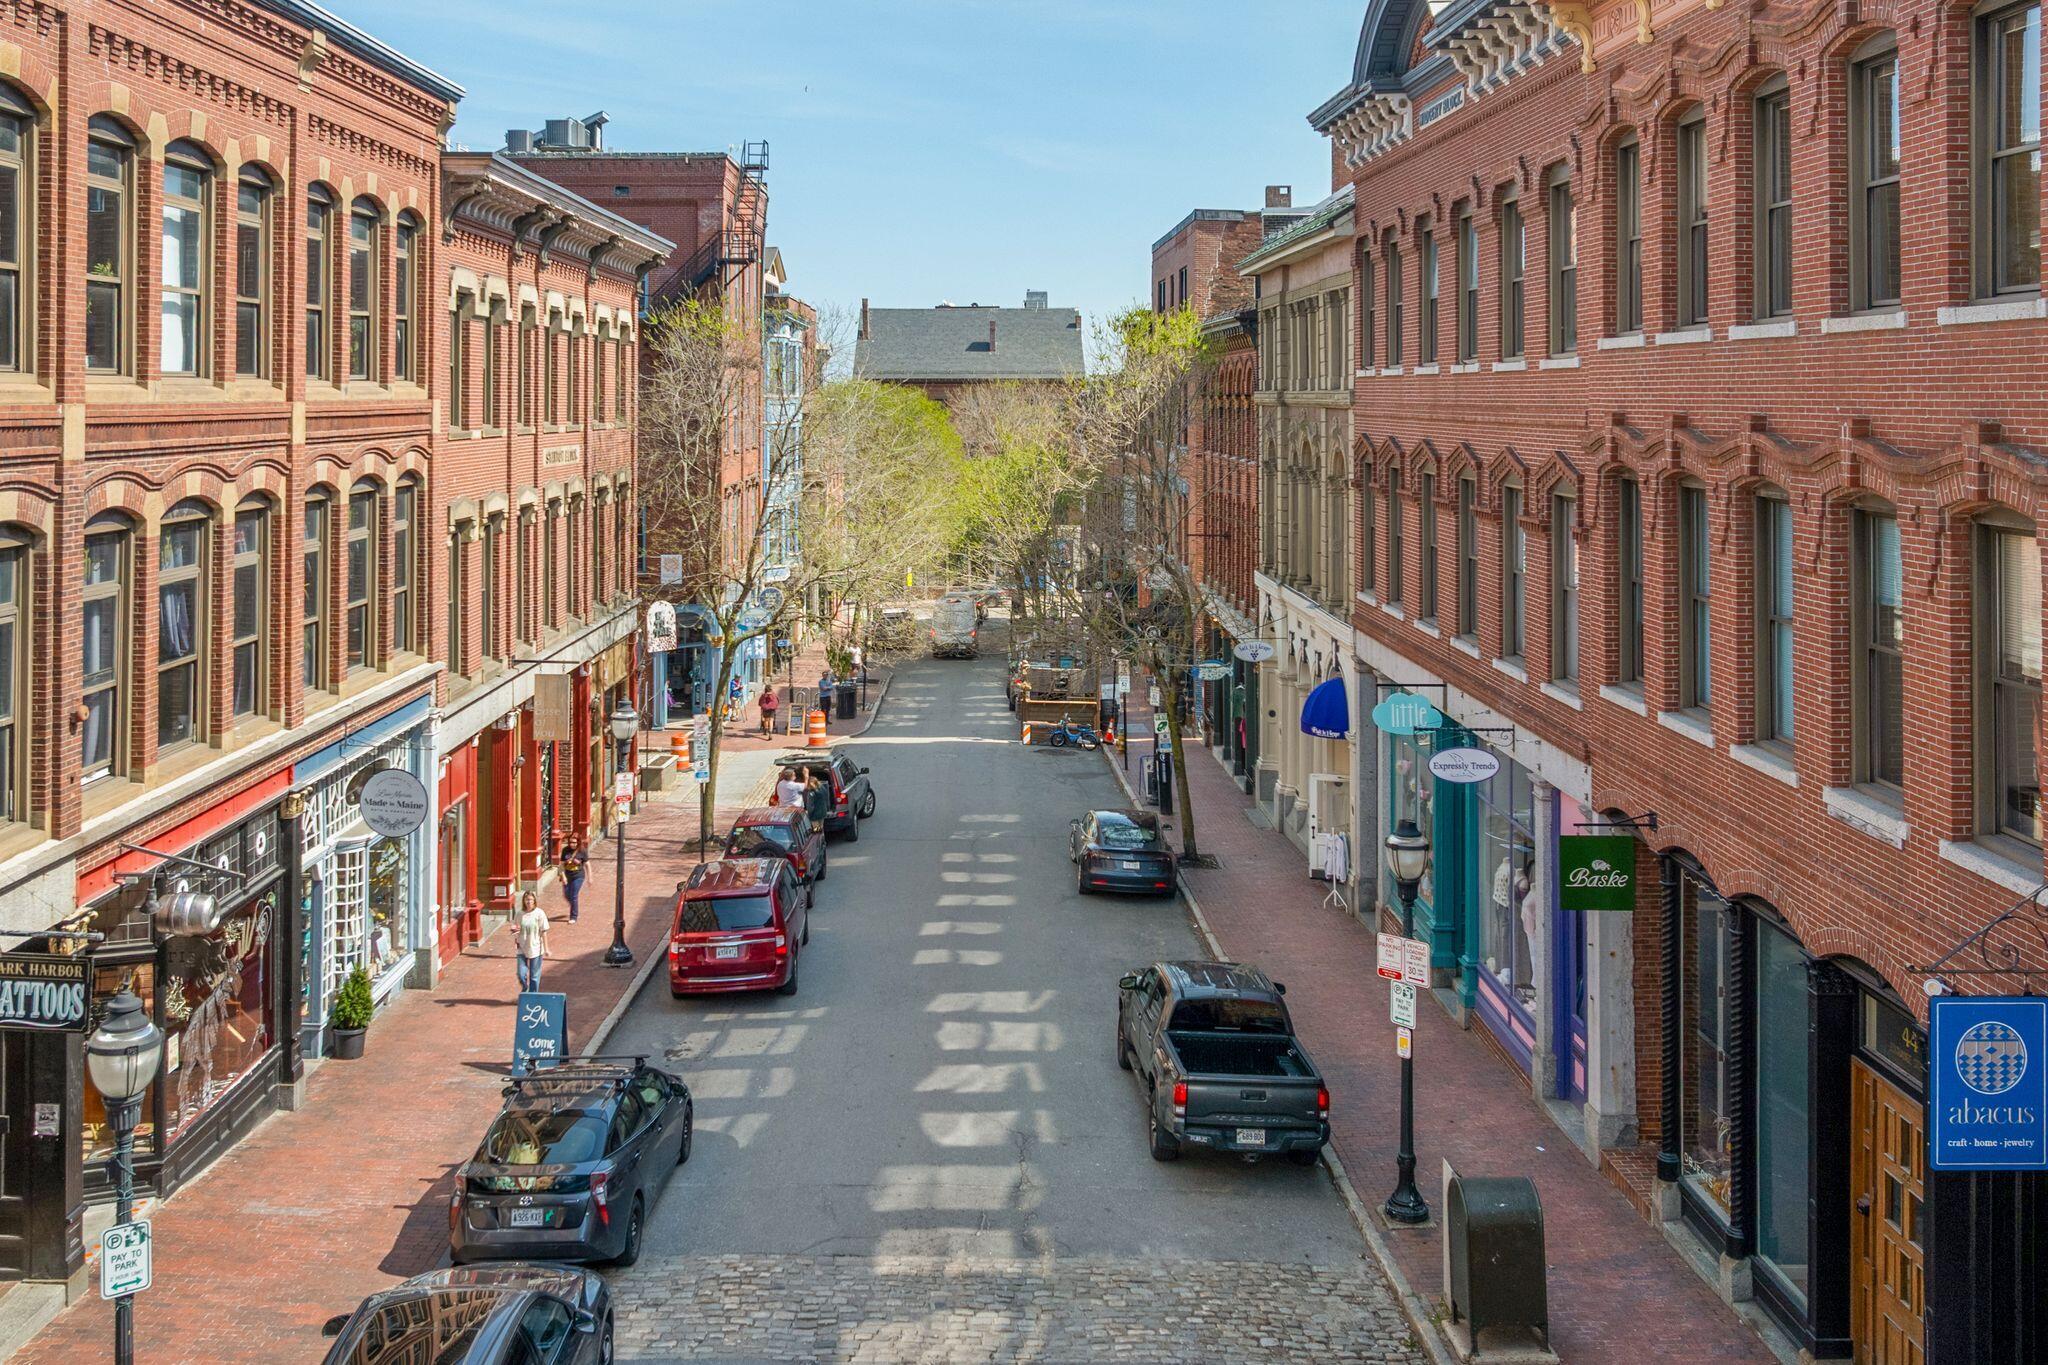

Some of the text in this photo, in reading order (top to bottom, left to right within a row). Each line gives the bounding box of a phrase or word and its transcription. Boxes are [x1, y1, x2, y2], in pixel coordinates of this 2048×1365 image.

[1391, 703, 1428, 728] little
[1433, 762, 1496, 771] Expressly Trends
[364, 798, 388, 807] Made
[396, 800, 424, 809] Maine
[1565, 867, 1628, 887] Baske
[1379, 941, 1401, 951] PARKING
[1407, 943, 1426, 951] VEHICLE
[1406, 948, 1427, 958] LOADING
[0, 962, 83, 977] ARK HARBOR
[1408, 966, 1417, 975] 30
[0, 981, 85, 1020] ATTOOS
[529, 1038, 555, 1049] come
[1949, 1097, 2034, 1125] abacus
[1947, 1137, 2035, 1149] craft home jewelry
[110, 1248, 142, 1264] PAY TO
[114, 1259, 138, 1271] PARK
